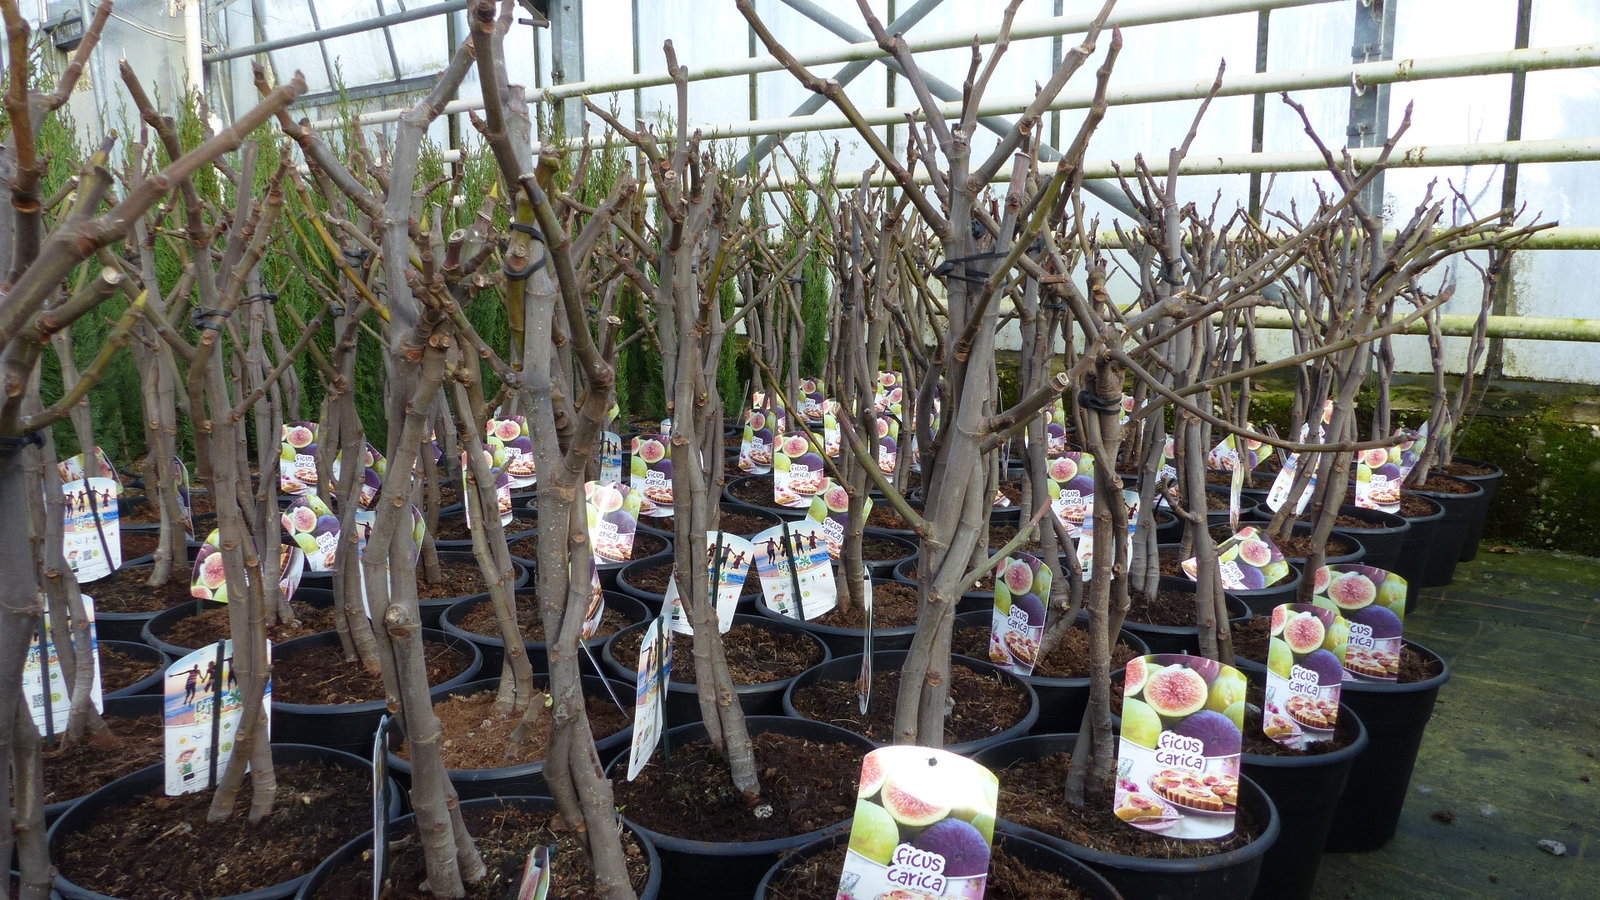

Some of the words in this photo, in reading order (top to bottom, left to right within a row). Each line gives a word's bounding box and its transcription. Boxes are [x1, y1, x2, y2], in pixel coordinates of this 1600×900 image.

[1061, 490, 1079, 498] ficus
[1010, 605, 1028, 622] ficus
[1007, 616, 1028, 633] carica
[1349, 624, 1370, 636] cus
[1292, 667, 1317, 683] ficus
[1288, 680, 1318, 696] carica
[1161, 734, 1200, 753] ficus
[1156, 751, 1203, 769] carica
[896, 848, 942, 872] ficus
[887, 869, 943, 892] carica
